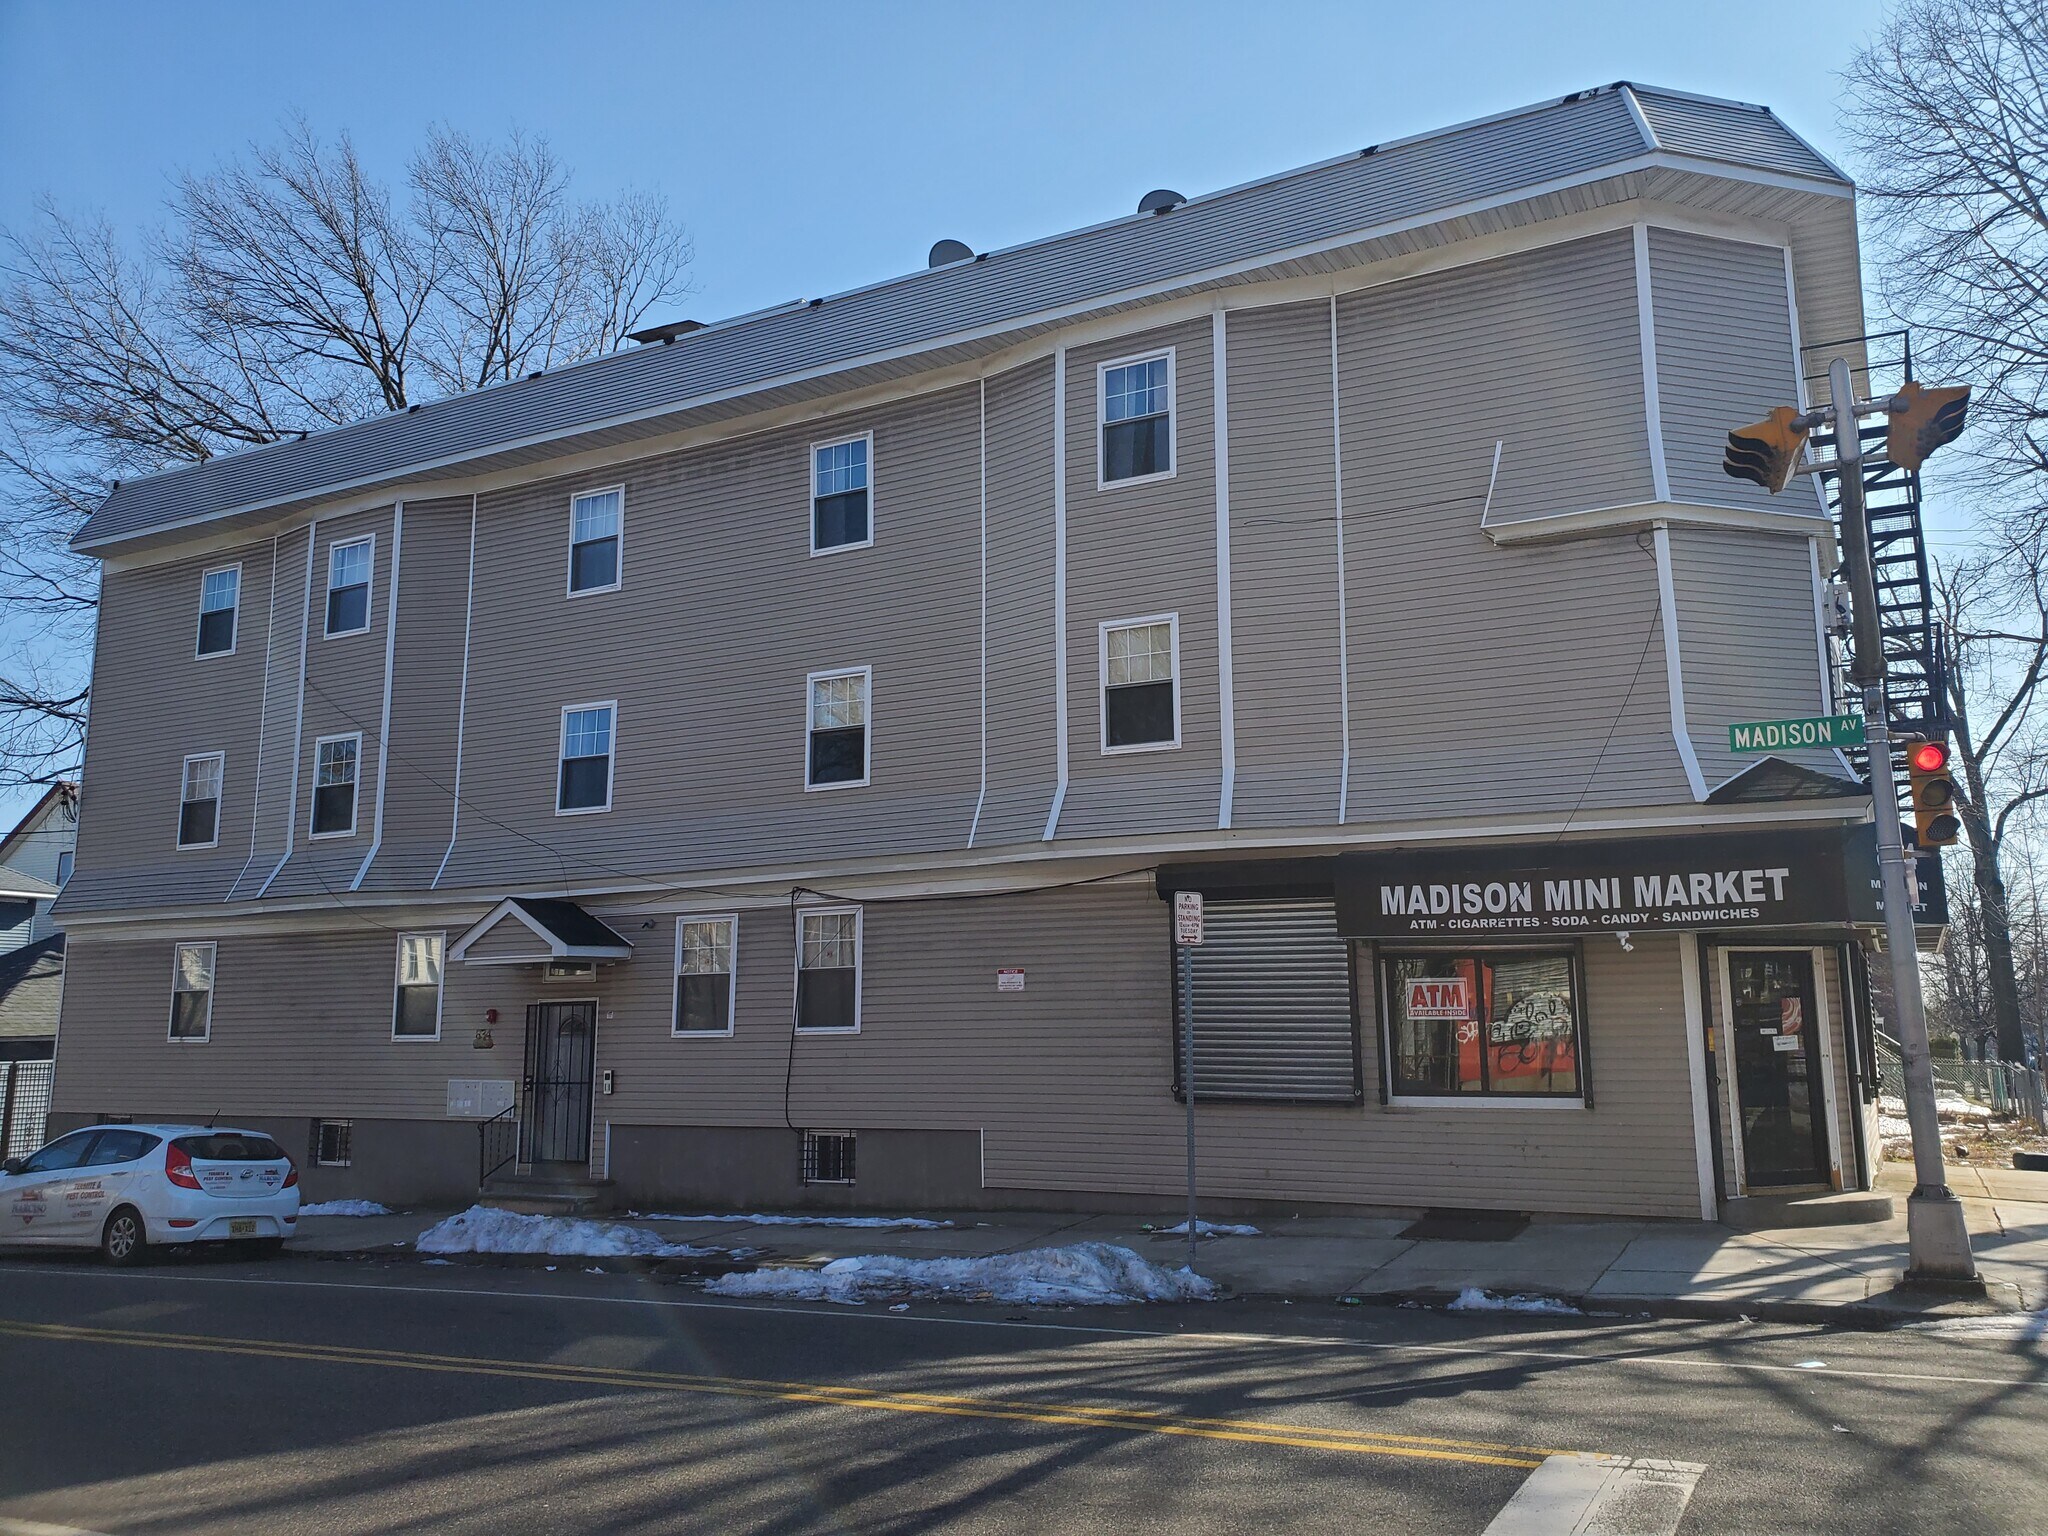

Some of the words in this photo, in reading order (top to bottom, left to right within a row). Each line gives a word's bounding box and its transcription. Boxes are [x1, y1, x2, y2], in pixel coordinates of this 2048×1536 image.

[1735, 721, 1832, 749] MADISON
[1841, 719, 1857, 731] AV
[1380, 881, 1533, 916] MADISON
[1543, 877, 1621, 912] MINI
[1633, 867, 1790, 908] MARKET
[1178, 903, 1199, 911] PARKING
[1409, 919, 1437, 929] ATM
[1448, 917, 1540, 928] CIGARRETTES
[1551, 915, 1590, 926] SODA
[1601, 913, 1649, 925] CANDY
[1662, 908, 1760, 922] SANDWICHES
[1411, 984, 1463, 1007] ATM
[80, 1190, 105, 1199] CONTROL
